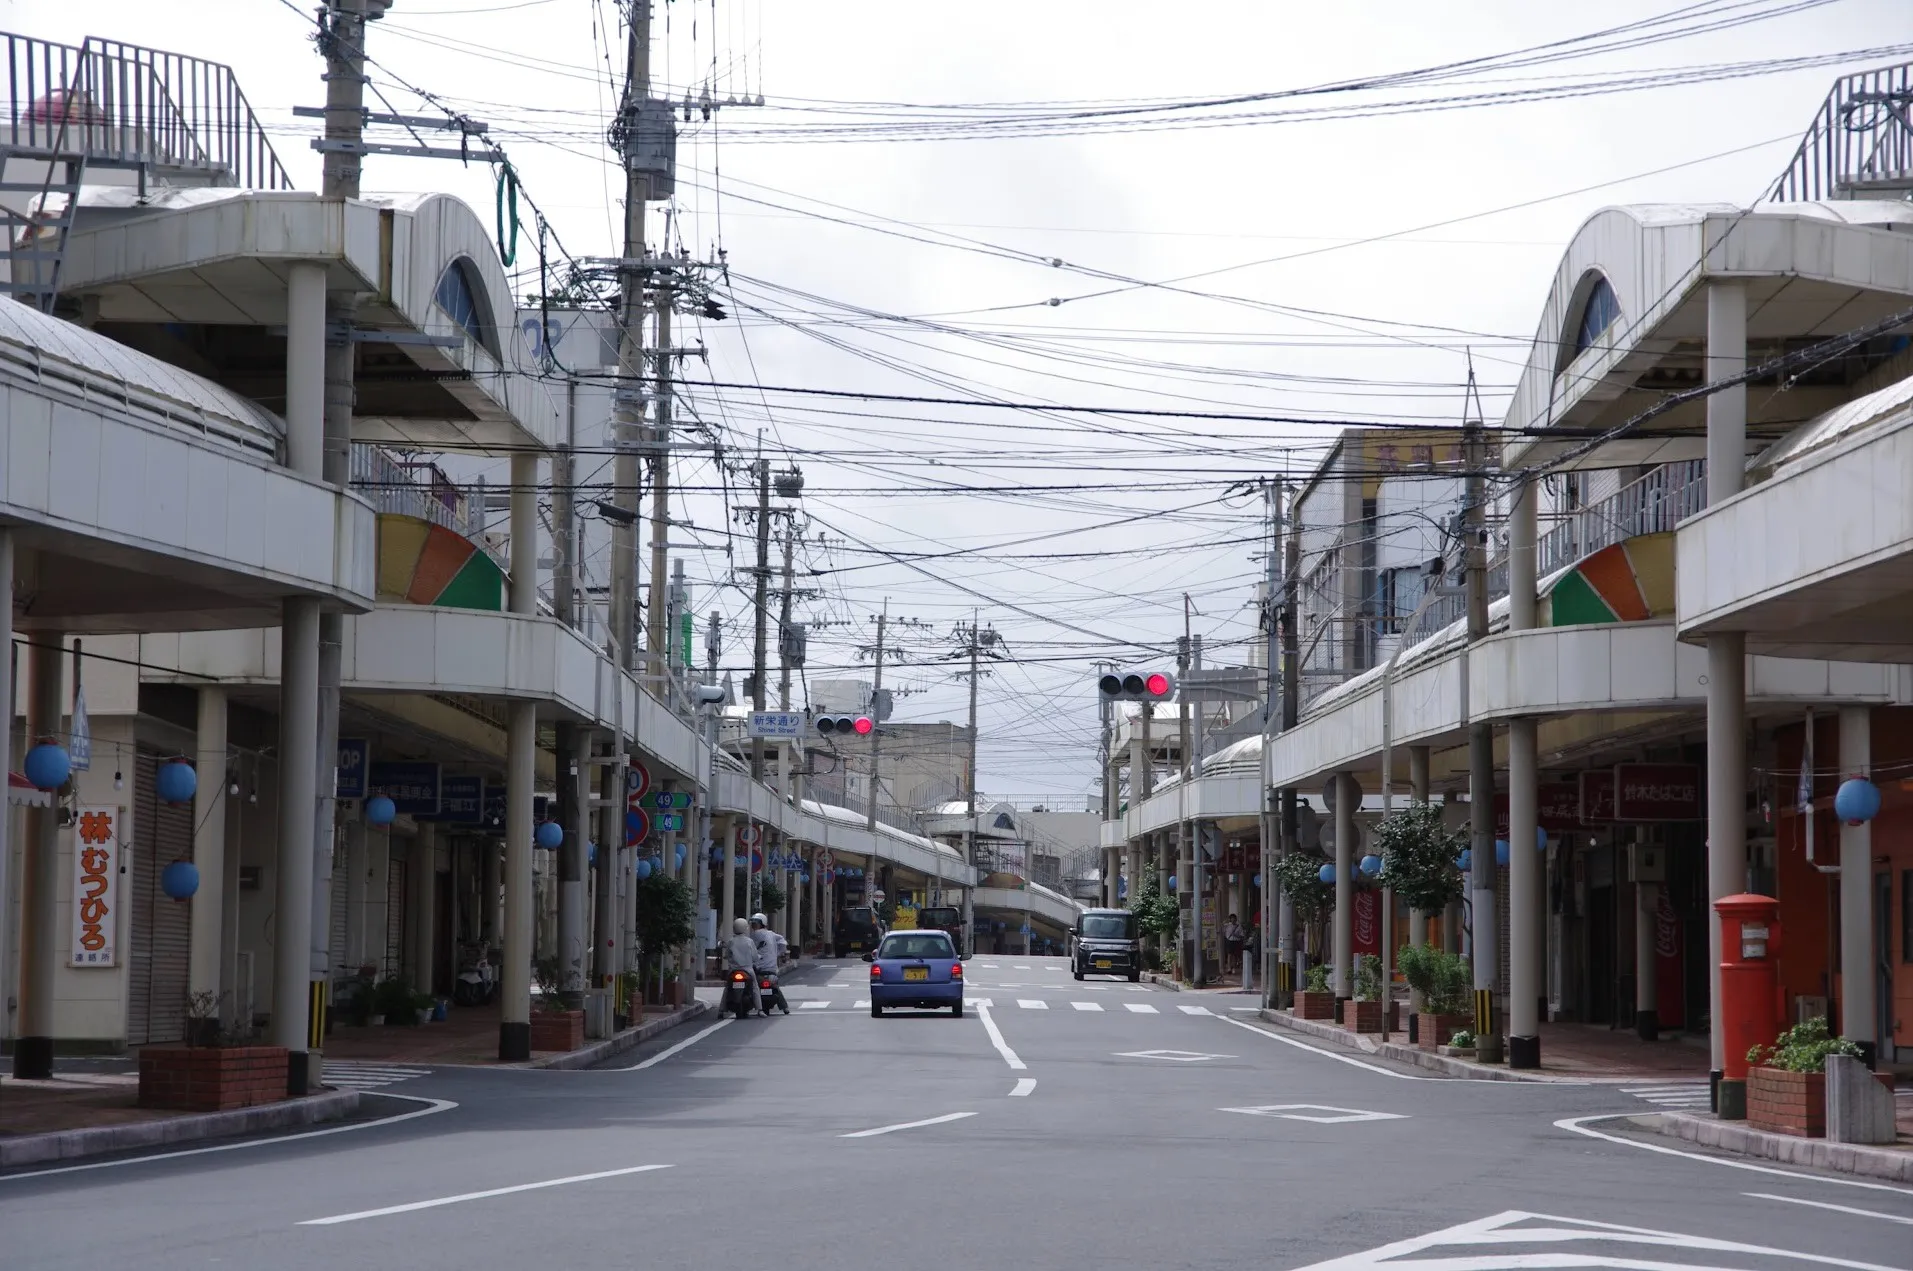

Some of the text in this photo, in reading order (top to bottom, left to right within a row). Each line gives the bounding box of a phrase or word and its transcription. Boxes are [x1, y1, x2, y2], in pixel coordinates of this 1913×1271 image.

[754, 715, 799, 726] 新栄通り
[1624, 784, 1696, 801] 鈴木たばこ店
[658, 796, 671, 805] 49
[664, 818, 672, 828] 49
[75, 953, 110, 962] 連絡所
